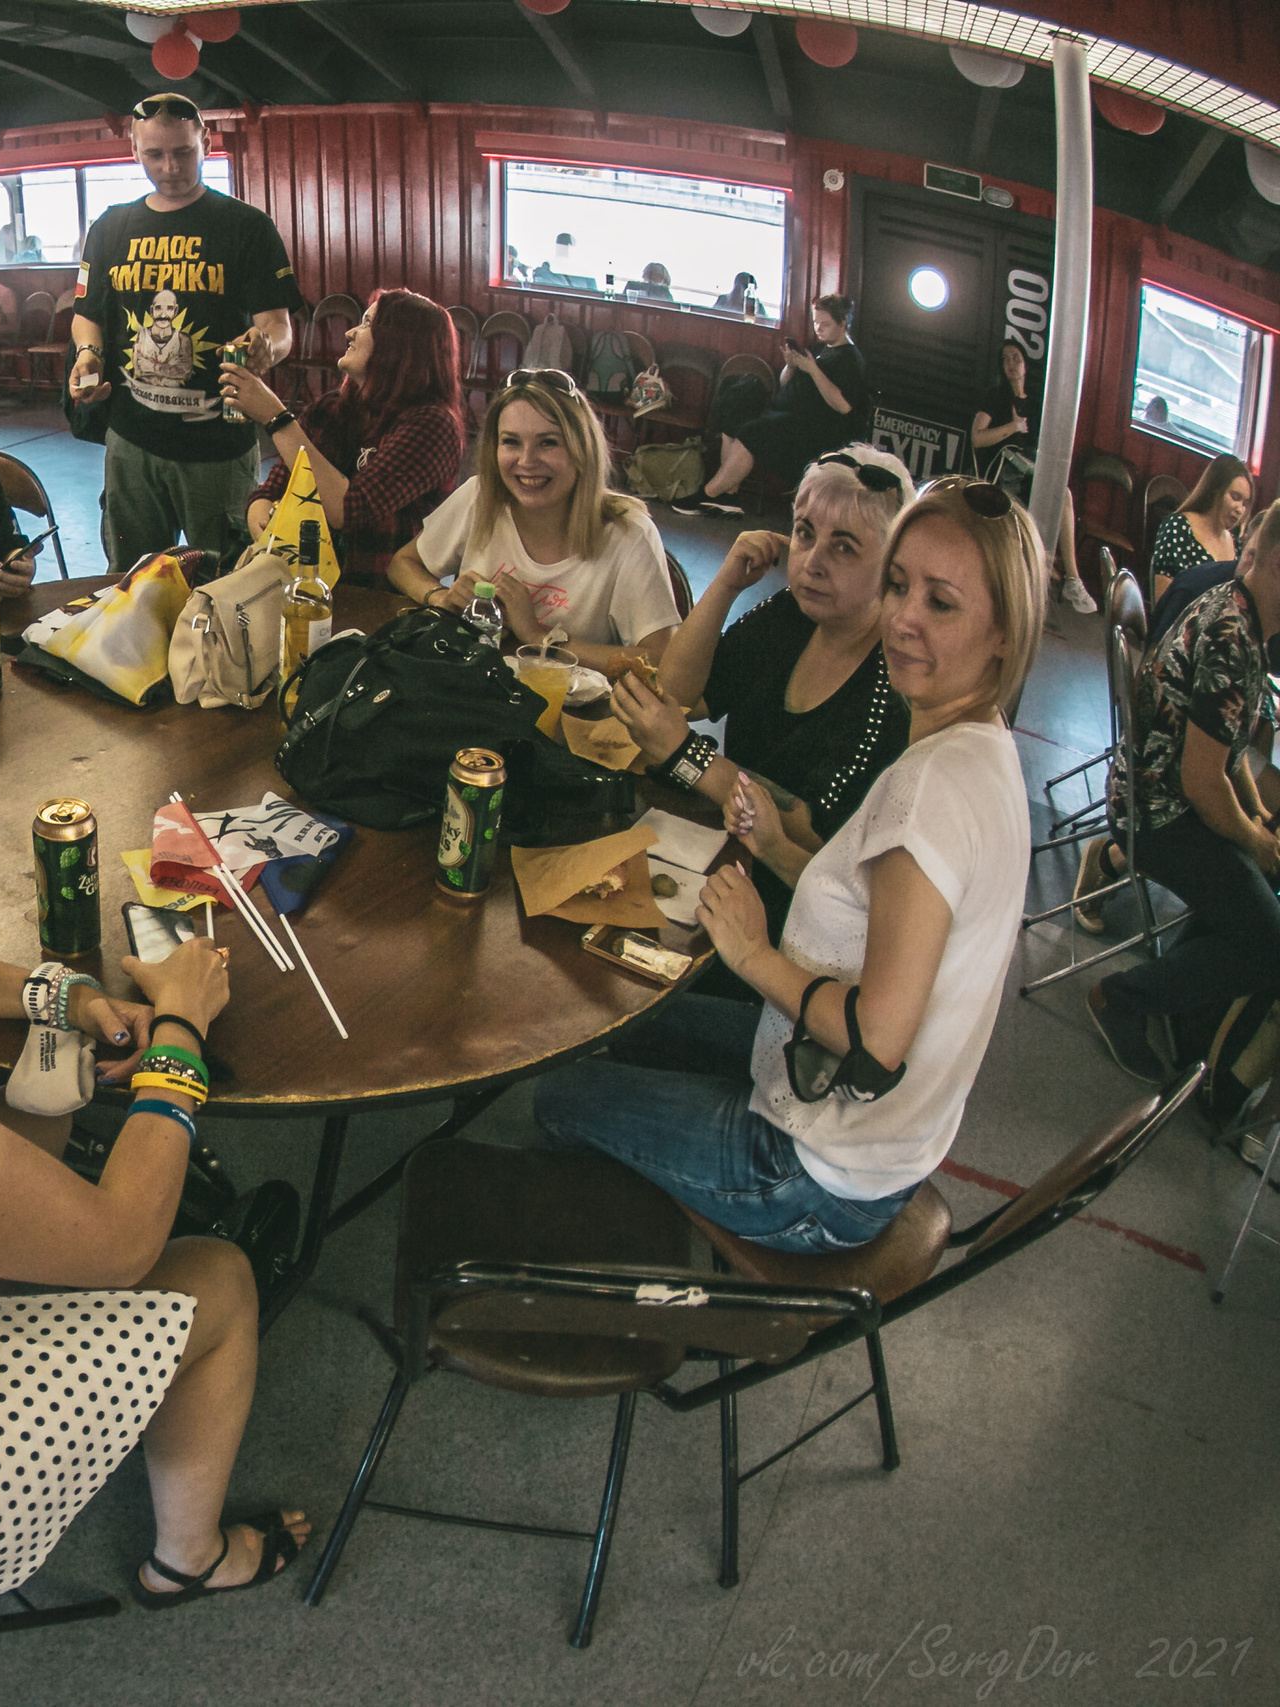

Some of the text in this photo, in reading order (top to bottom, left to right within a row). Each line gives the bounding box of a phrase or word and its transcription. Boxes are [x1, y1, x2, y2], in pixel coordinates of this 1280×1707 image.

[127, 235, 202, 262] ГОЛОС
[1004, 269, 1049, 360] 002
[874, 414, 941, 444] EMERGENCY
